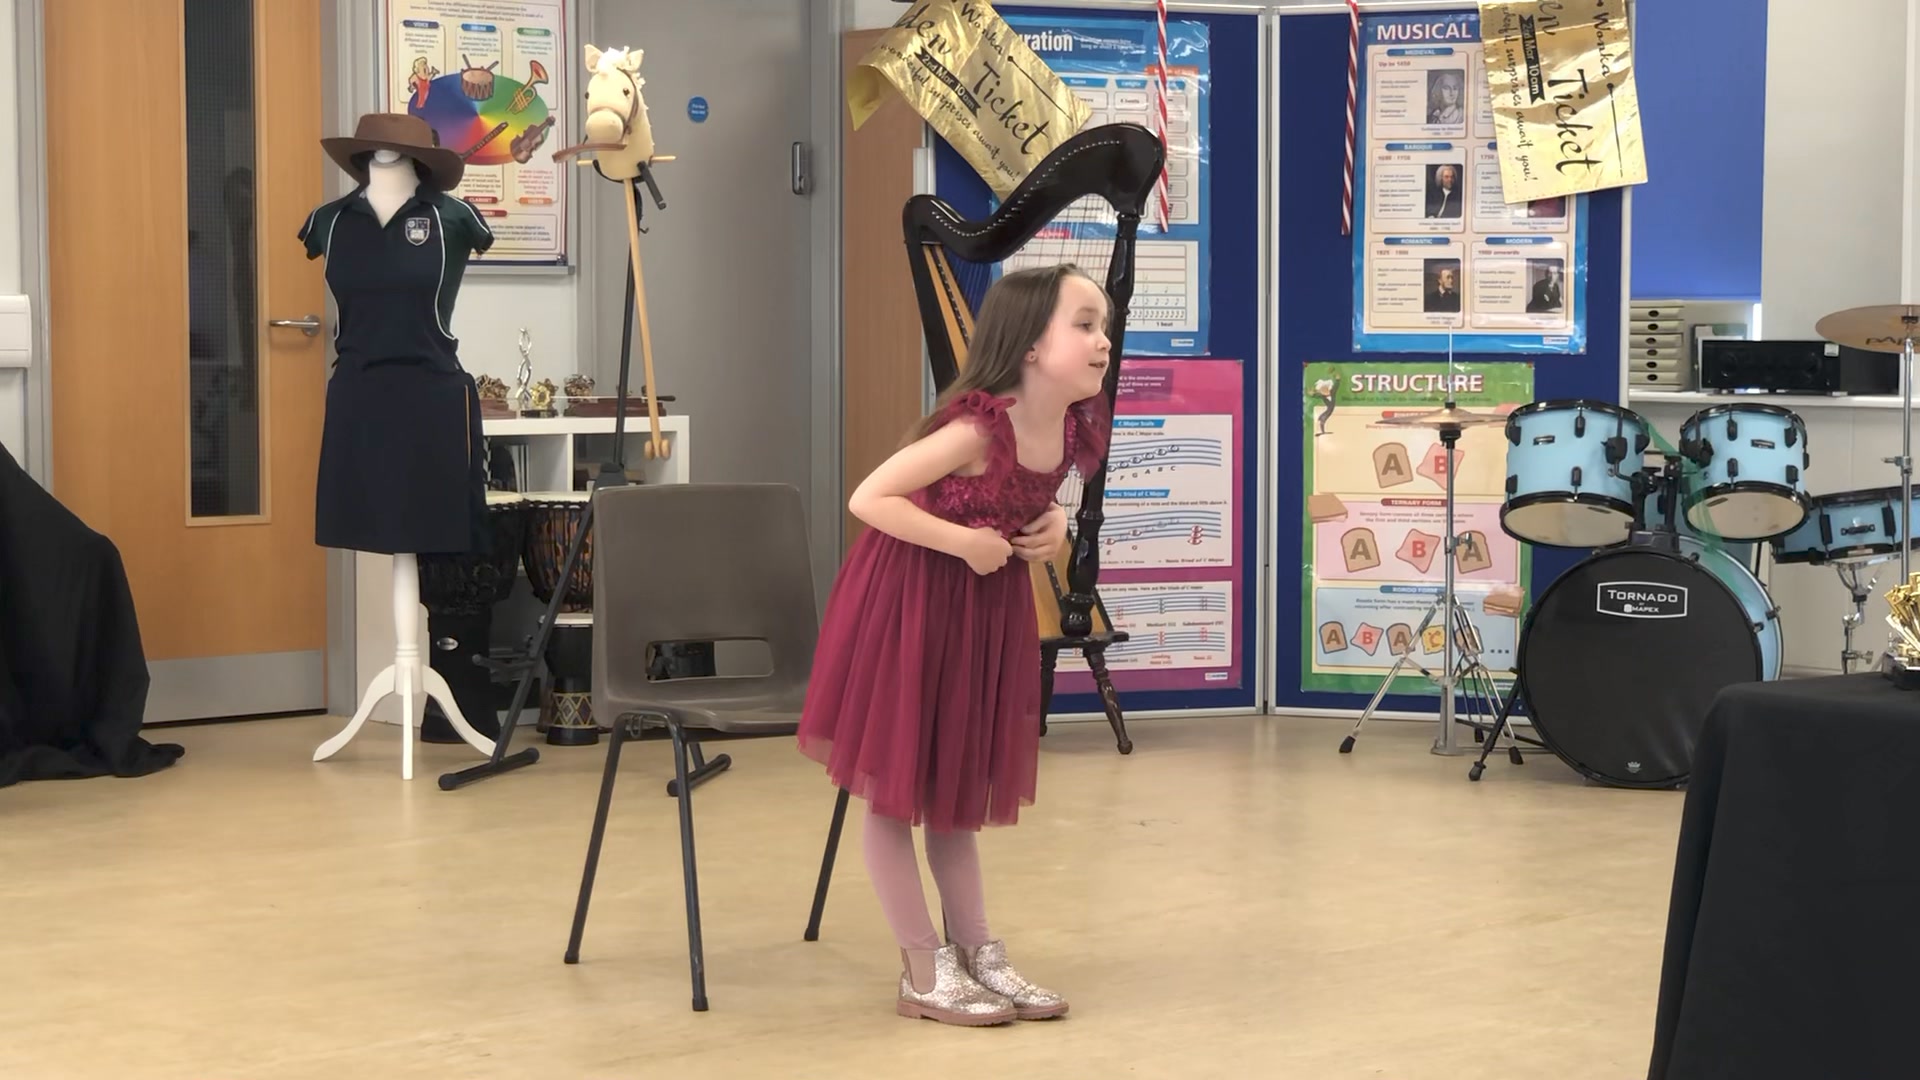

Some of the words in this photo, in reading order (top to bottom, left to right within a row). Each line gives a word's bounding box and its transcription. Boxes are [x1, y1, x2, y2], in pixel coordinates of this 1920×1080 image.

[961, 2, 1003, 55] Wonka
[1377, 23, 1472, 40] MUSICAL
[1524, 39, 1536, 60] Mar
[1592, 12, 1614, 77] Wonka
[922, 54, 937, 71] 2nd
[936, 66, 954, 85] Mar
[953, 83, 975, 110] 10am
[1503, 48, 1525, 106] surprises
[1528, 64, 1539, 95] 10am
[973, 60, 1050, 155] Ticket
[1547, 68, 1603, 177] Ticket
[927, 86, 972, 129] surprises
[973, 129, 1001, 160] await
[996, 159, 1020, 182] you!
[1515, 111, 1534, 148] await
[1515, 155, 1538, 181] you!
[1351, 374, 1484, 392] STRUCTURE
[1381, 453, 1404, 476] A
[1434, 455, 1448, 475] B
[1350, 538, 1372, 560] A
[1412, 540, 1426, 558] B
[1462, 540, 1483, 562] A
[1607, 589, 1678, 603] TORNADO
[1326, 629, 1342, 645] A
[1362, 631, 1373, 645] B
[1393, 631, 1409, 646] A
[1428, 630, 1441, 647] C
